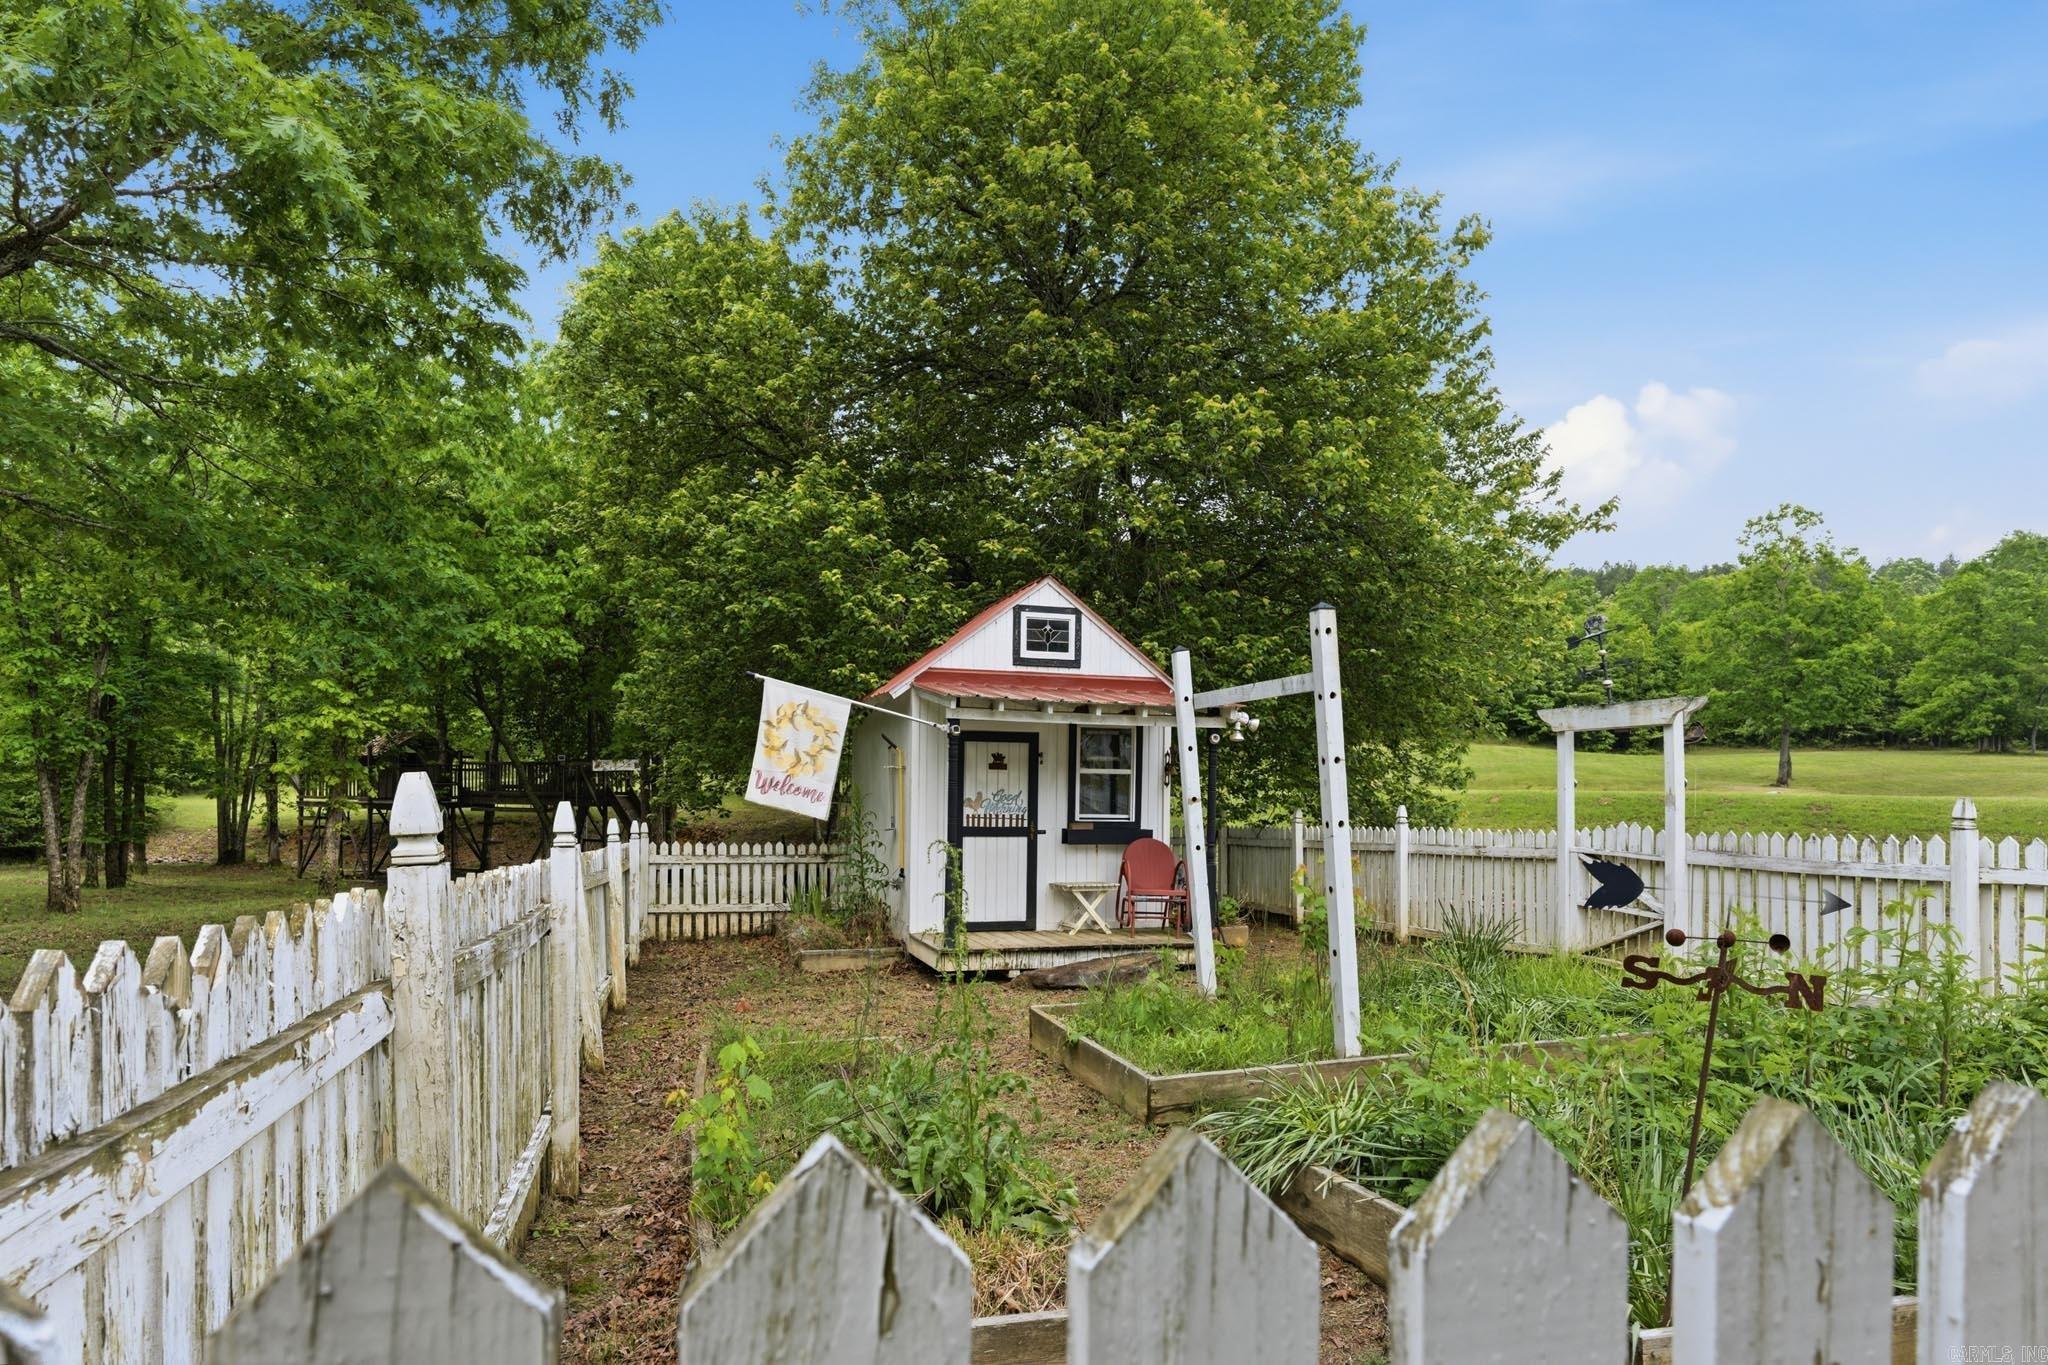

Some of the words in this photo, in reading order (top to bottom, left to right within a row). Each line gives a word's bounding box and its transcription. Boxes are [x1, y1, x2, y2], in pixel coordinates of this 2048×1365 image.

[755, 769, 825, 803] Welcome
[991, 788, 1023, 805] Good
[1621, 954, 1660, 990] S
[1784, 972, 1827, 1012] N
